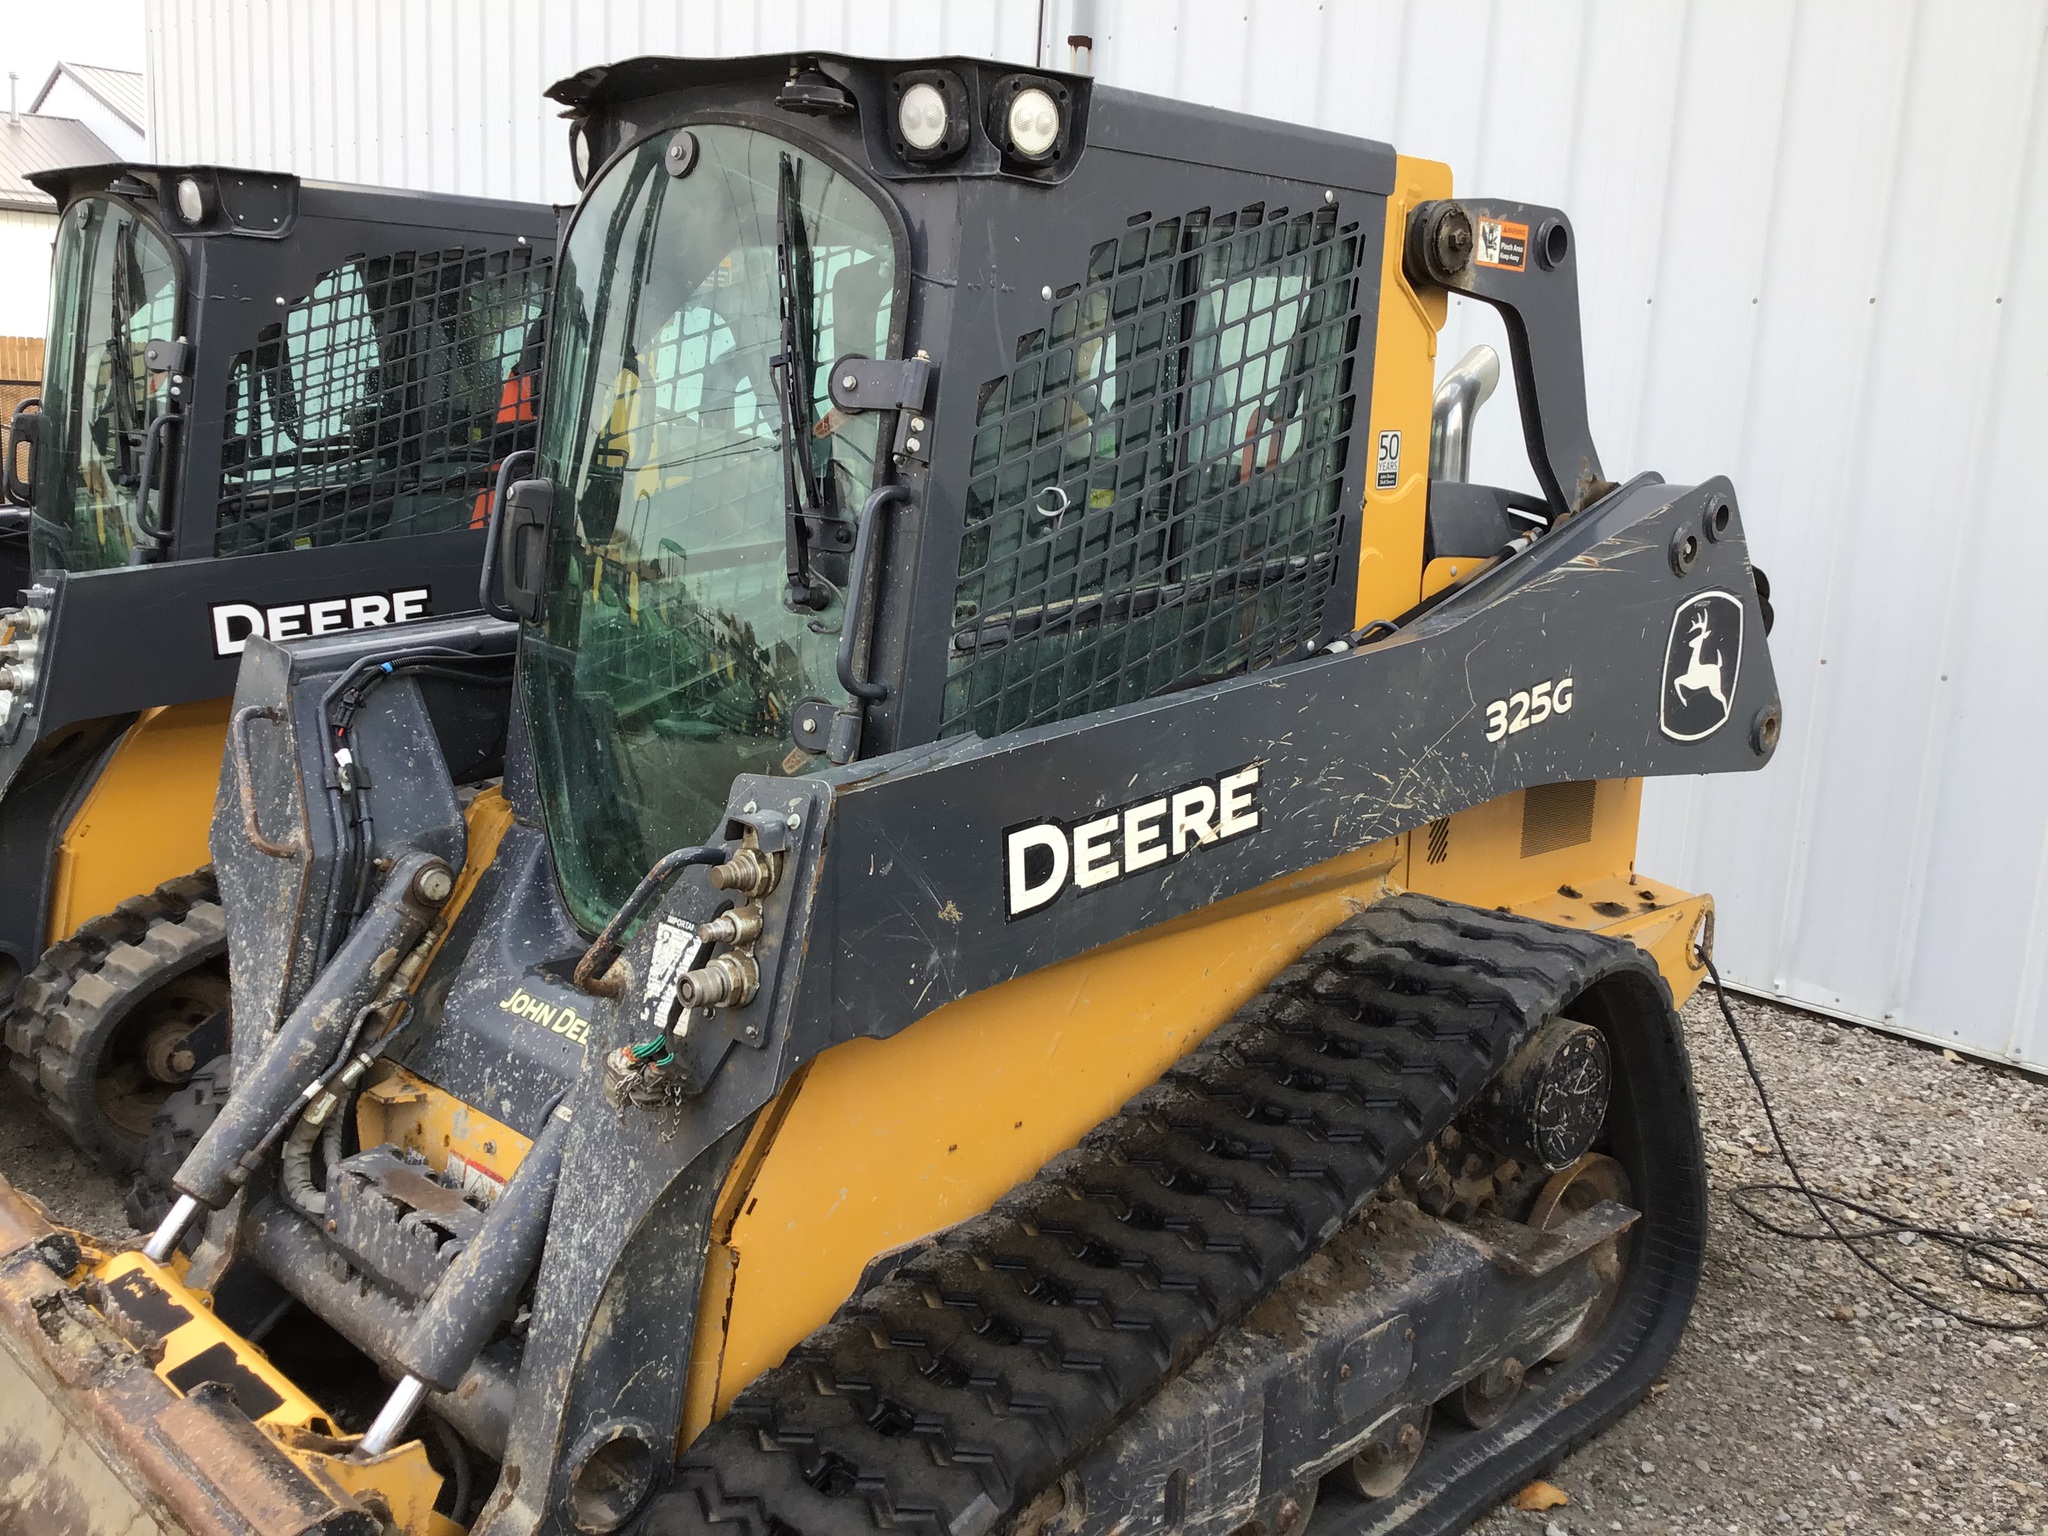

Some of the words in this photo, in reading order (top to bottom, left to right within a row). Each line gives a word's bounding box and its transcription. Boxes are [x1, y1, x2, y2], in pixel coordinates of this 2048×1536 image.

[1501, 242, 1513, 251] Pinch
[1513, 245, 1523, 253] Area
[1378, 461, 1398, 471] YEARS
[1379, 434, 1399, 461] 50
[213, 589, 428, 655] DEERE
[1486, 678, 1573, 743] 325G
[1008, 768, 1259, 915] DEERE
[499, 987, 558, 1027] JOHN
